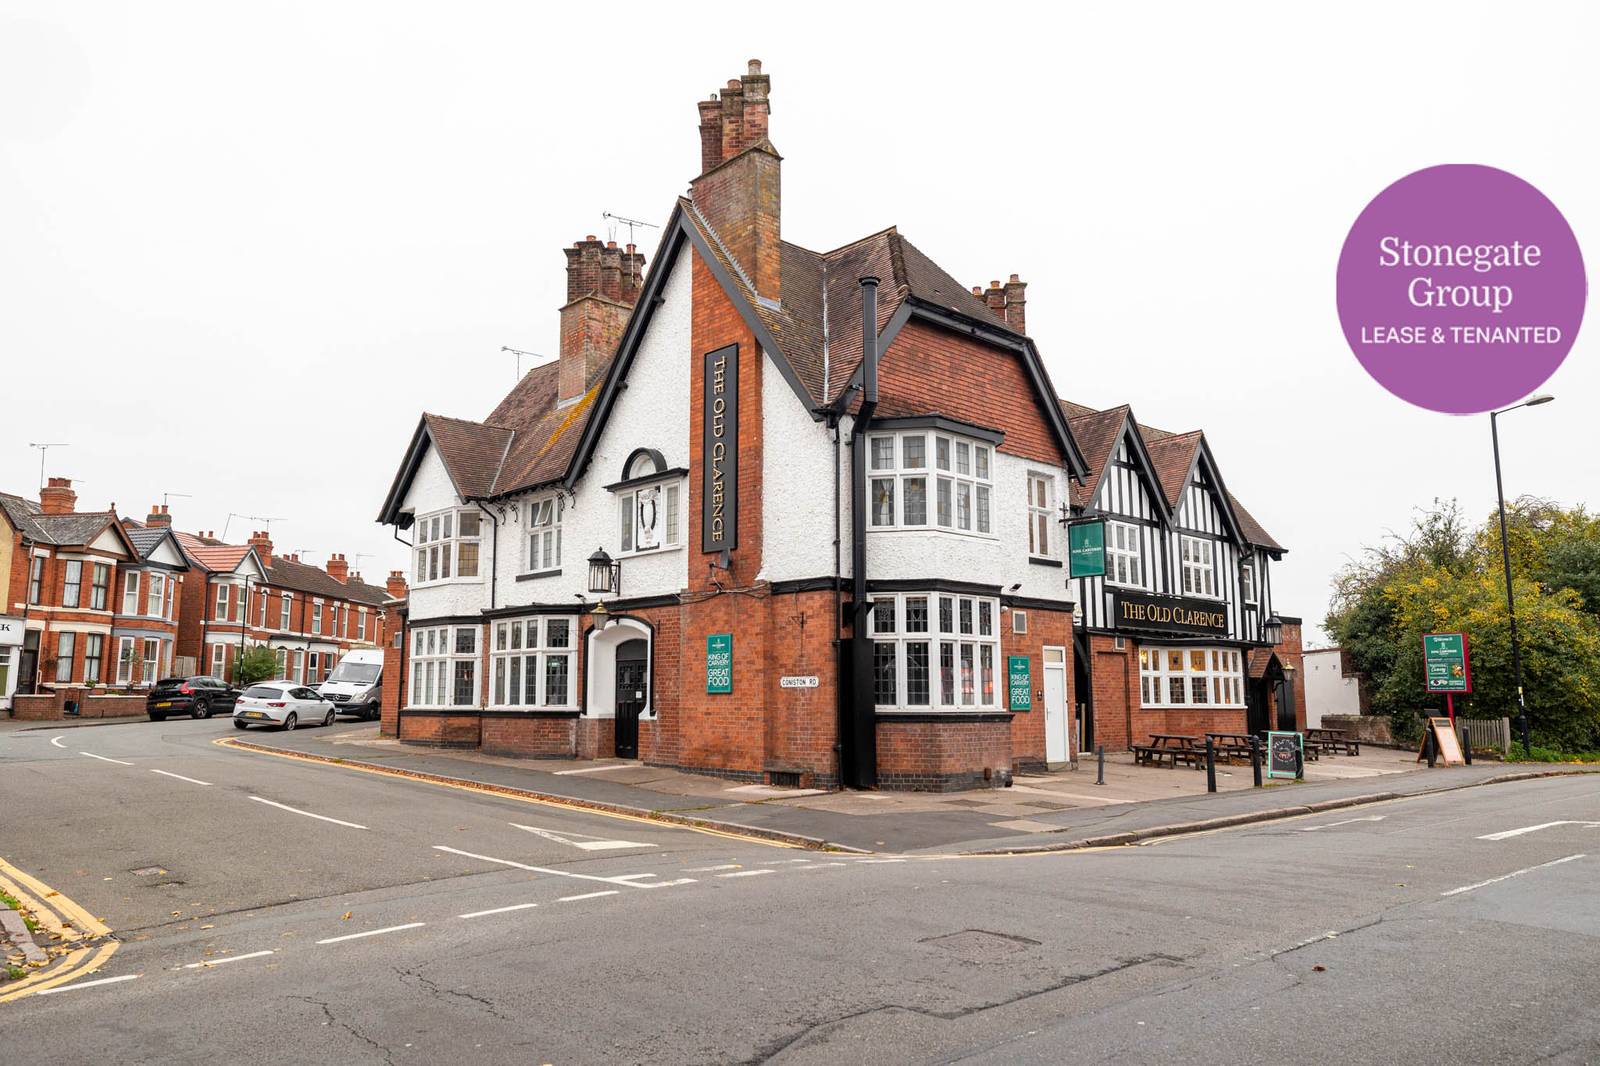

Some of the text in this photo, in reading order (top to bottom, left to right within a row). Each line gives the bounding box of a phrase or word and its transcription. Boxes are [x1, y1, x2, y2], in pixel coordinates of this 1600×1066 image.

[712, 356, 726, 542] THE OLD CLARENCE
[1121, 601, 1224, 628] THE OLD CLARENCE
[708, 677, 730, 686] FOOD
[1011, 695, 1030, 704] FOOD
